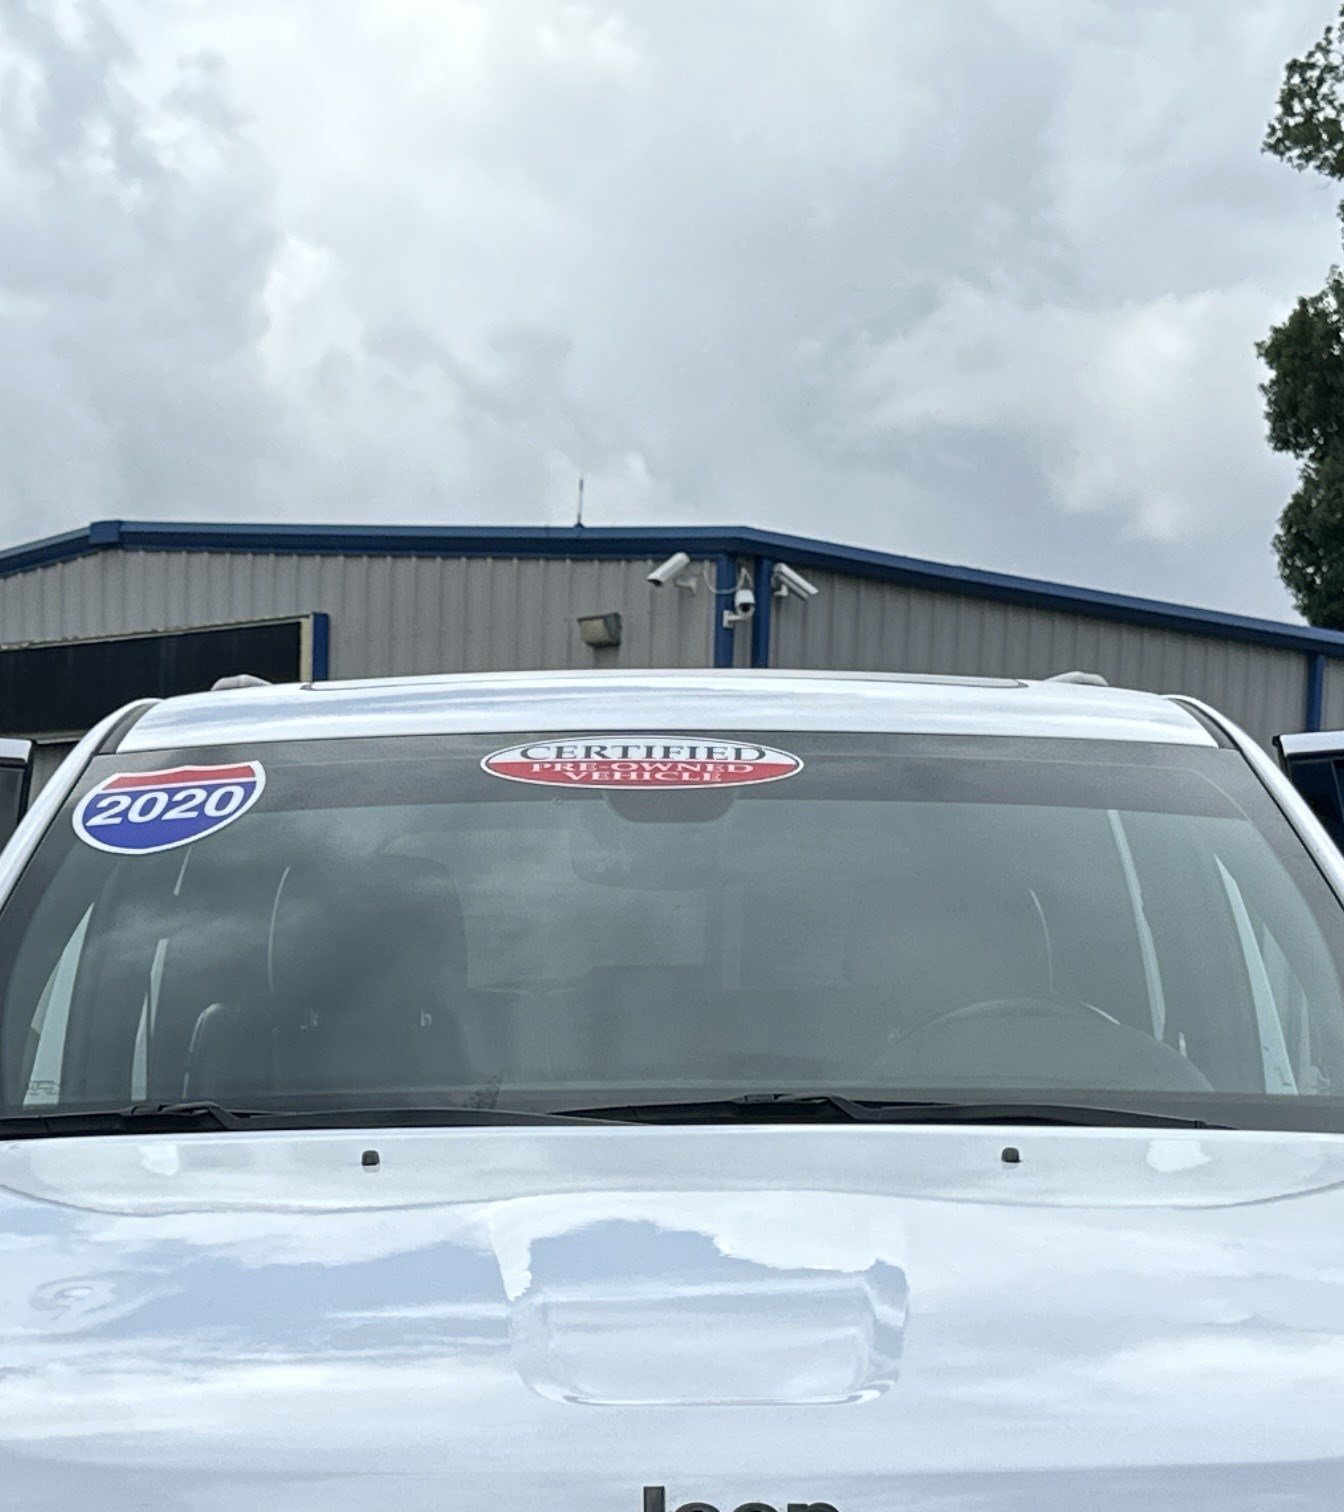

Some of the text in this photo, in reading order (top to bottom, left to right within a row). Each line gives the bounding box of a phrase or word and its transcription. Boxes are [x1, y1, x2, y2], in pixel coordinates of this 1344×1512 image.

[520, 745, 766, 762] CERTIFIED
[530, 762, 755, 774] PRE-OWNED
[566, 771, 722, 782] VEHICLE
[85, 785, 245, 827] 2020
